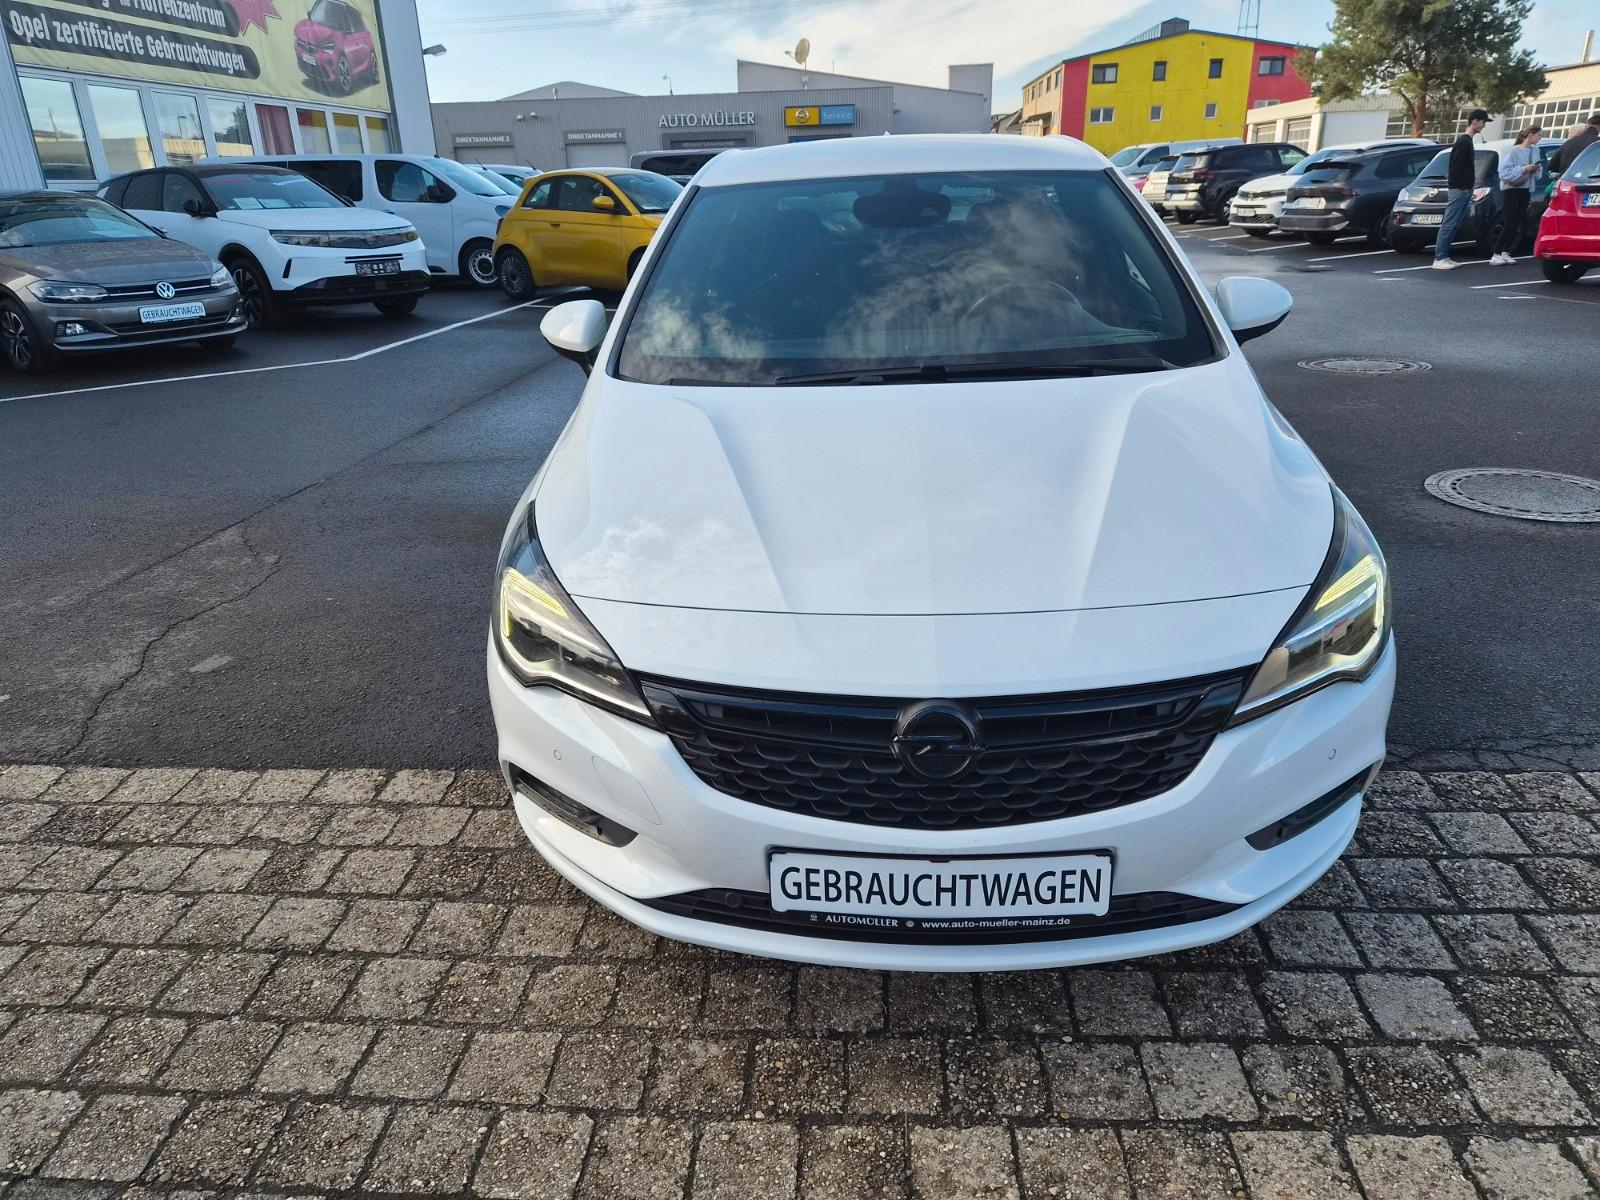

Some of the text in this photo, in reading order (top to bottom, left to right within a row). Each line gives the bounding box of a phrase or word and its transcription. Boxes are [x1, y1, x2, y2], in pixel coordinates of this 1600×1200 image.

[9, 10, 245, 74] Opel zertifizierte Gebrauchtwagen
[659, 110, 755, 127] AUTO MÜLLER
[823, 110, 852, 120] Service
[142, 305, 204, 319] GEBRAUCHTWAGEN
[780, 866, 1102, 907] GEBRAUCHTWAGEN
[825, 914, 1071, 929] AUTOMÜLLER www.auto-mueller-mainz.de
